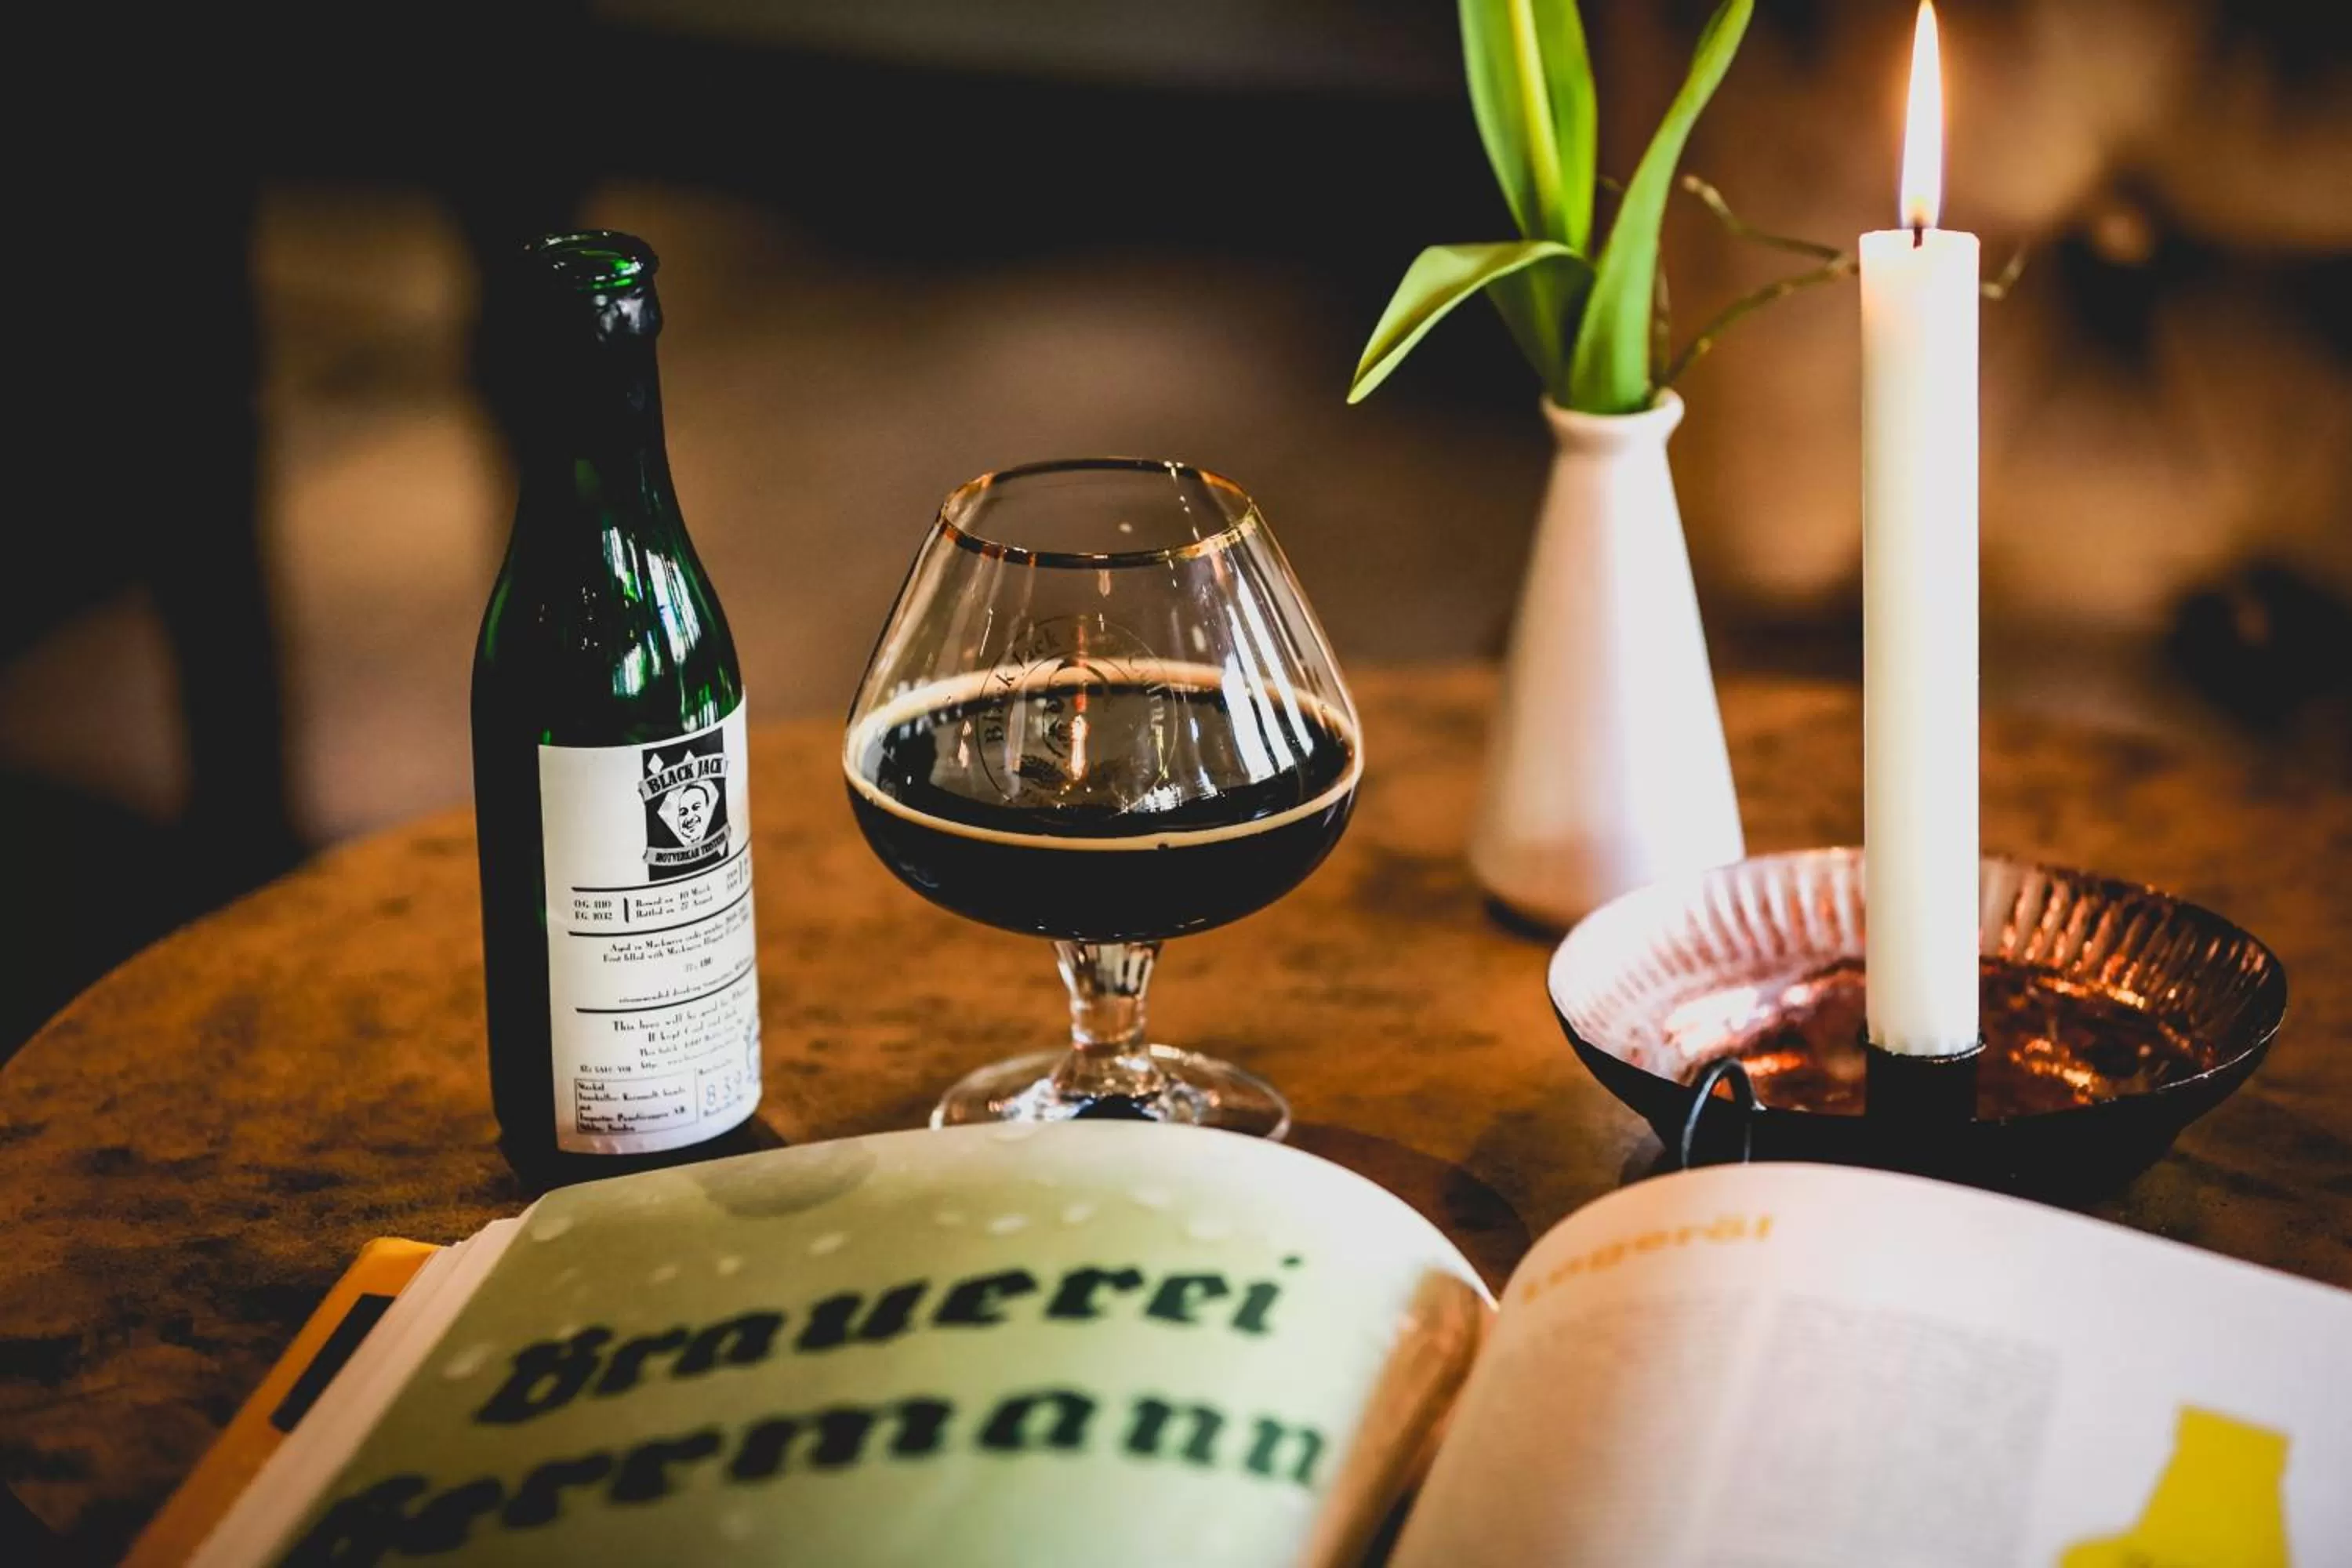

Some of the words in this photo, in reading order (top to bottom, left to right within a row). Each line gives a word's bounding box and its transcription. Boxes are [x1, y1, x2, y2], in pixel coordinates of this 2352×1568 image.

[646, 763, 694, 794] BLACK
[698, 757, 723, 779] JACK
[475, 1254, 1302, 1425] Brauerei
